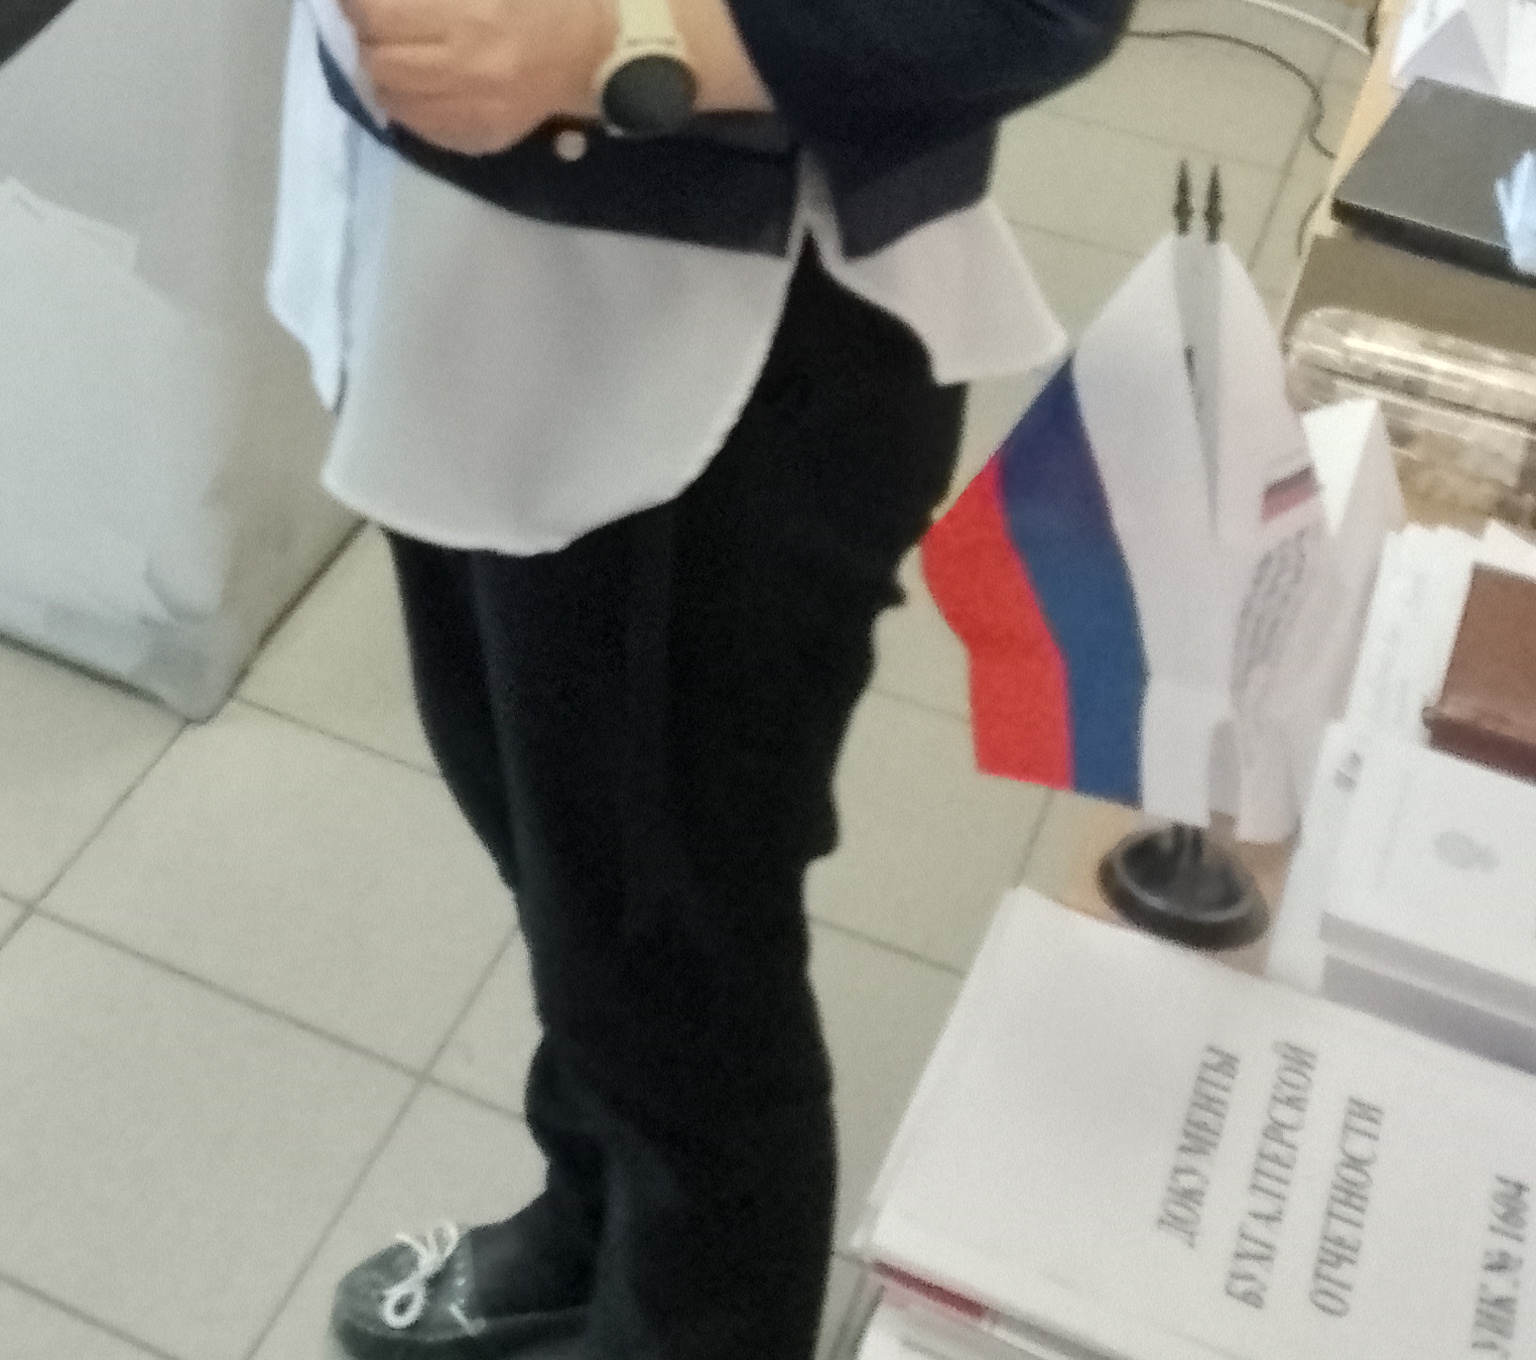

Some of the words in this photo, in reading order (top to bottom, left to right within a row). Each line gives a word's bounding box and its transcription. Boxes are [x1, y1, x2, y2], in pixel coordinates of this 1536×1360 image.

[1158, 1043, 1241, 1249] ДОКУМЕНТЫ
[1224, 1040, 1319, 1309] БУХГАЛТЕРСКОЙ
[1309, 1095, 1385, 1319] ОТЧЕТНОСТИ
